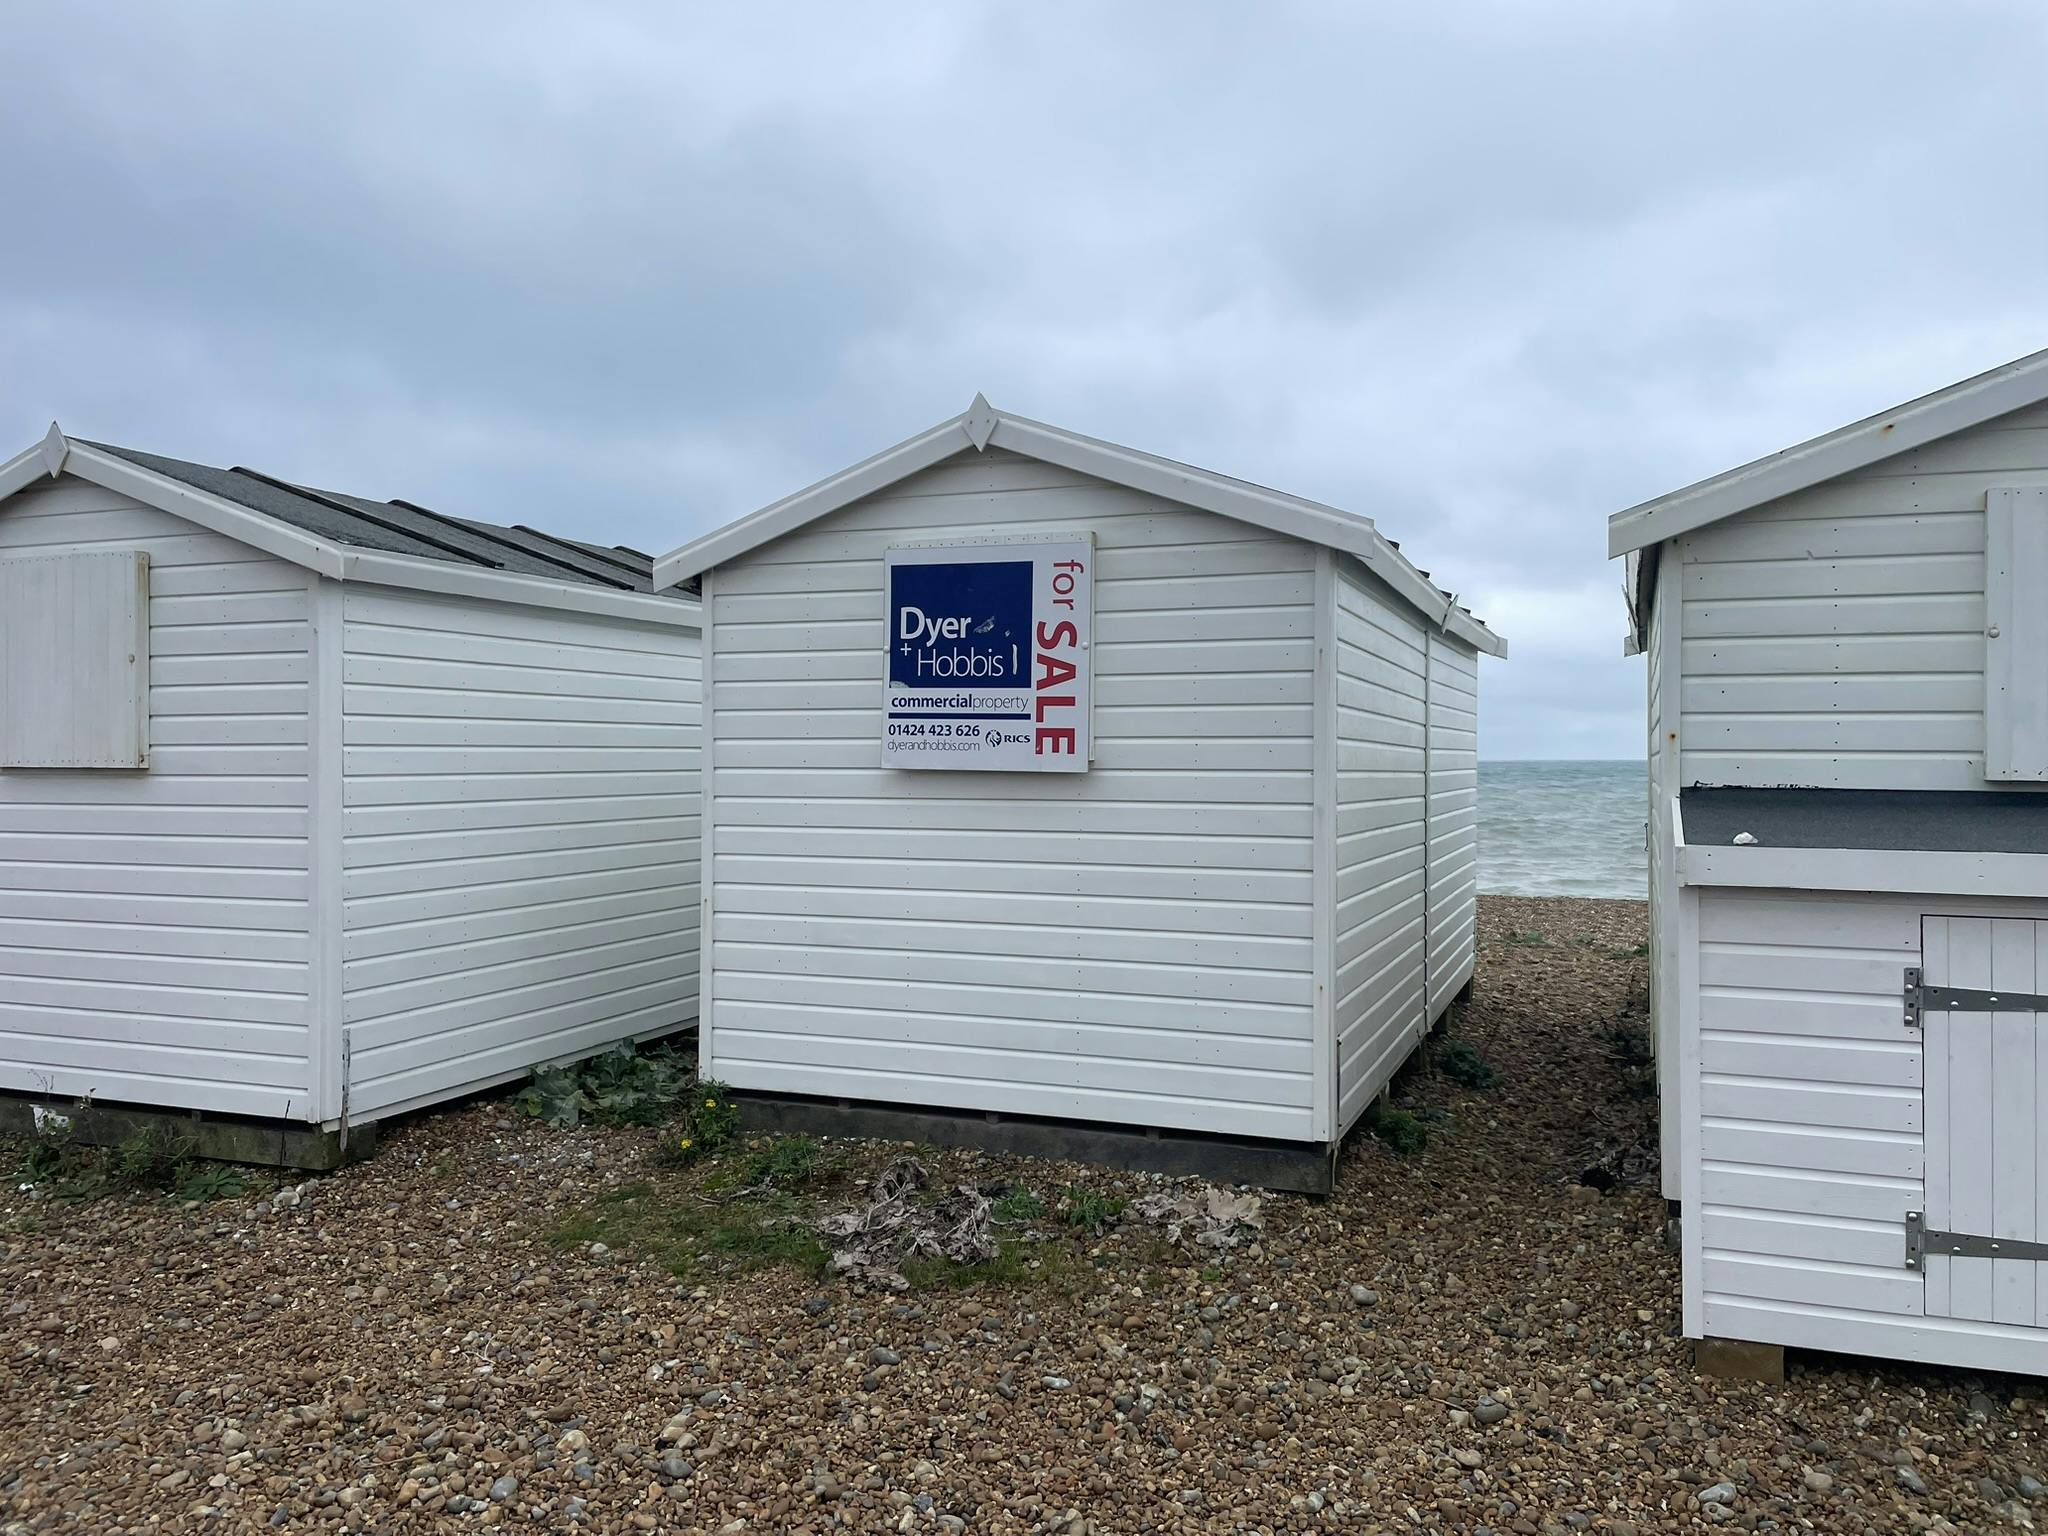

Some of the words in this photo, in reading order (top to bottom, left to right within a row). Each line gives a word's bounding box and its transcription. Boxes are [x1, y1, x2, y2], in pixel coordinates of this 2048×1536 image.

[1052, 559, 1084, 610] for
[900, 606, 972, 648] Dyer
[917, 647, 1004, 677] Hobbis
[1035, 620, 1078, 755] SALE
[891, 693, 1029, 712] commercialproperty
[888, 723, 925, 736] 01424
[928, 724, 952, 736] 423
[955, 724, 980, 737] 626
[1004, 734, 1031, 743] RICS
[887, 739, 980, 752] dyerandhobbis.com
